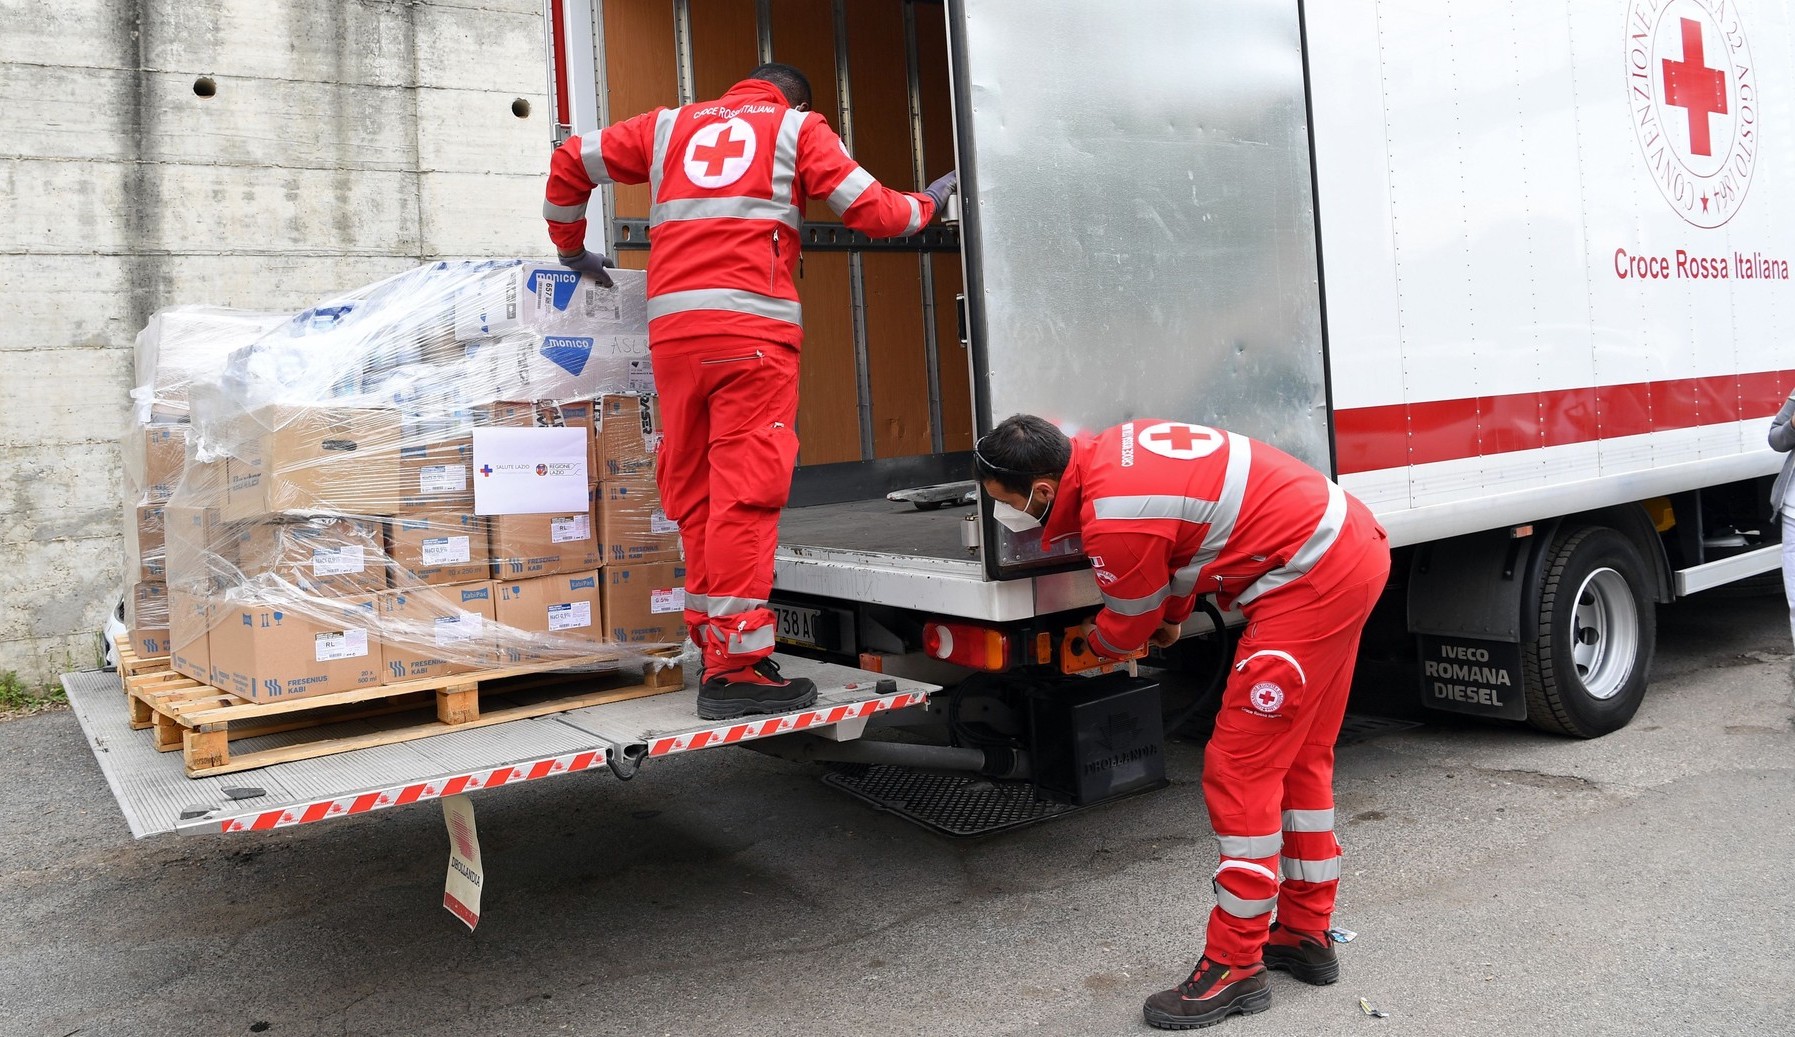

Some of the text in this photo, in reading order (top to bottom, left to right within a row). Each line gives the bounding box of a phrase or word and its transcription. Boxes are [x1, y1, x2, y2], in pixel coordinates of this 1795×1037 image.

[1726, 21, 1743, 54] 22
[1735, 64, 1754, 178] AGOSTO
[693, 106, 718, 119] CROCE
[741, 104, 775, 114] ITALIANA
[1614, 247, 1790, 280] Croce Rossa Italiana
[545, 282, 553, 298] 657
[548, 338, 589, 349] monico
[462, 591, 487, 599] KabiPac
[773, 607, 799, 636] 738
[1441, 645, 1489, 662] IVECO
[369, 675, 377, 683] ml
[411, 667, 428, 675] KABI
[1424, 660, 1511, 686] ROMANA
[287, 675, 328, 687] FRESENIUS
[1434, 682, 1503, 707] DIESEL
[451, 856, 480, 888] DHOLLANDIA
